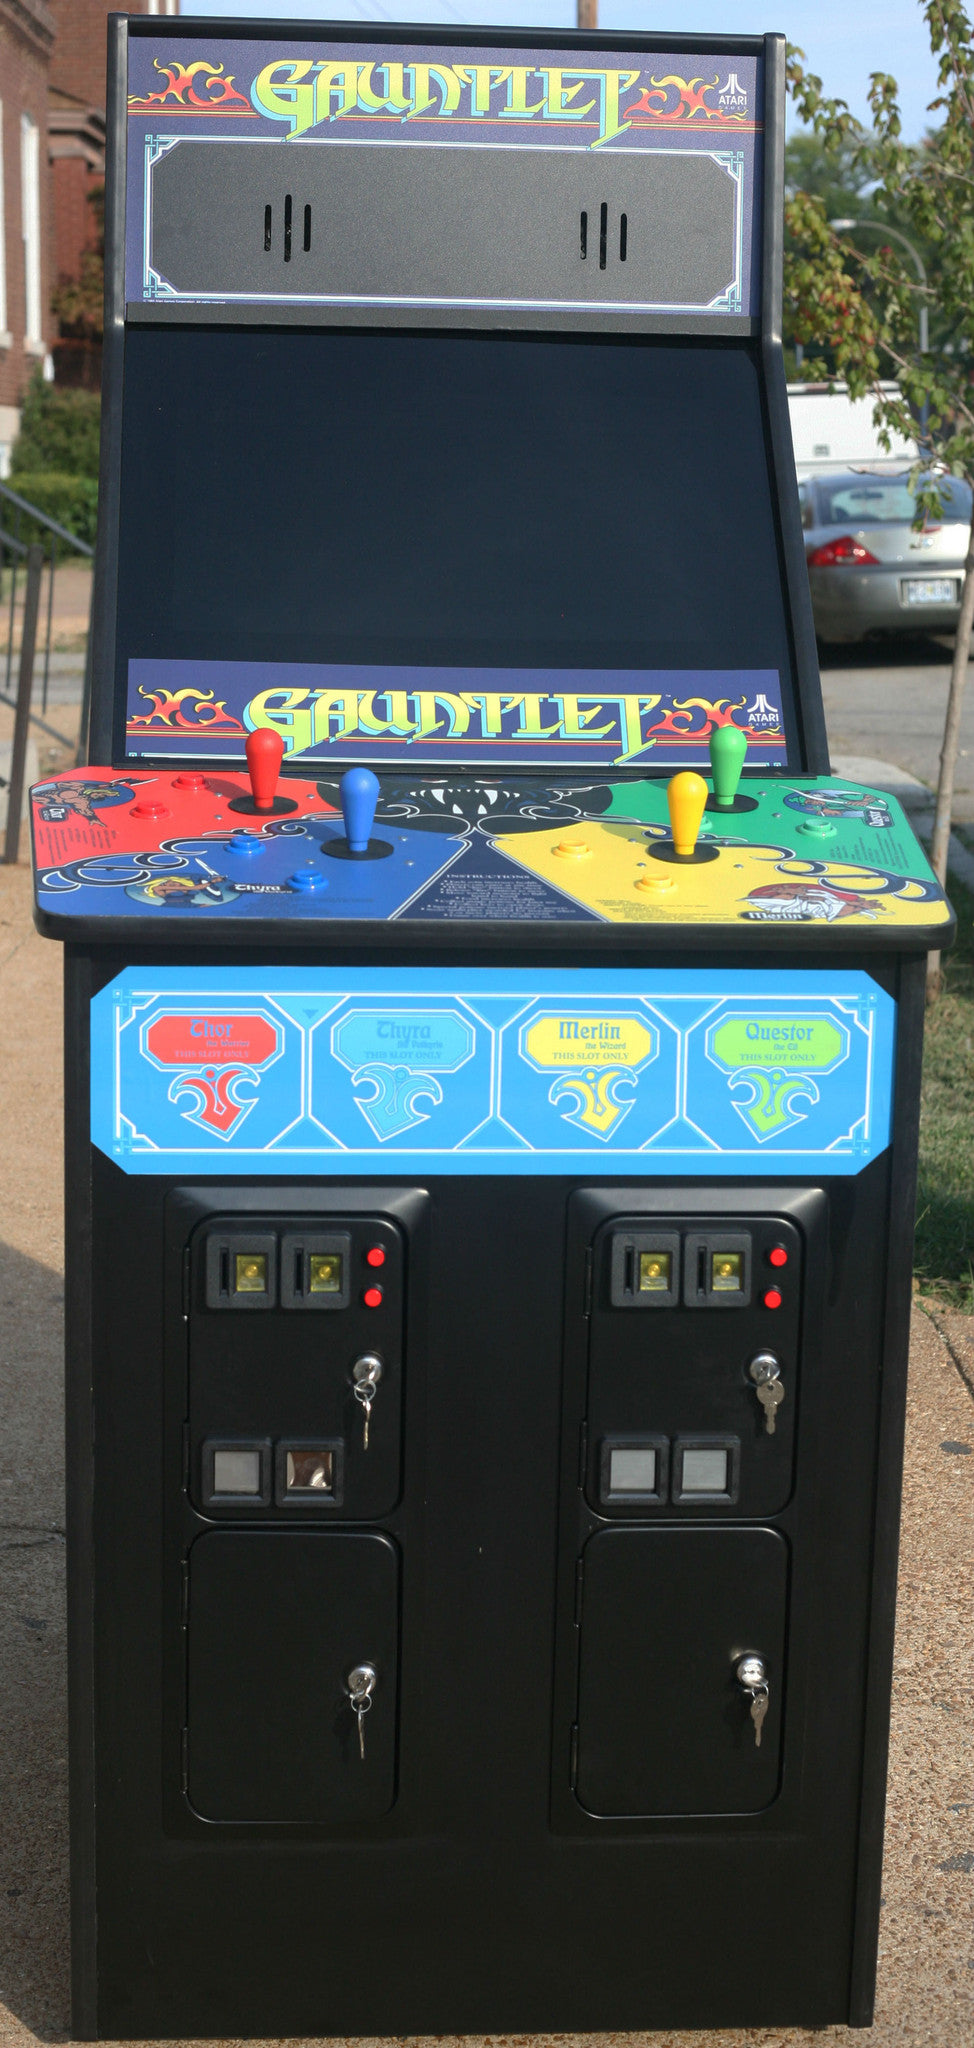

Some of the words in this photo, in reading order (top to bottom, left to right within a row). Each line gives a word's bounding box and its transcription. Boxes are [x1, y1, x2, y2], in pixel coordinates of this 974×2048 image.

[718, 95, 747, 105] ATARI
[250, 59, 641, 151] GAUNTLET
[748, 713, 779, 722] ATARI
[243, 687, 661, 767] GAUNTLET
[234, 883, 281, 893] Thyra
[748, 912, 803, 920] Merlin
[190, 1018, 233, 1038] Thor
[376, 1020, 431, 1043] Thyra
[559, 1021, 621, 1040] Merlin
[745, 1022, 815, 1041] Questor
[585, 1042, 597, 1050] the
[599, 1042, 627, 1050] Wizard
[773, 1043, 785, 1051] the
[174, 1050, 197, 1058] THIS
[198, 1050, 222, 1058] SLOT
[223, 1050, 250, 1058] ONLY
[364, 1051, 388, 1060] THIS
[389, 1051, 413, 1060] SLOT
[414, 1051, 443, 1060] ONLY
[552, 1052, 575, 1060] THIS
[576, 1052, 600, 1060] SLOT
[602, 1052, 630, 1060] ONLY
[739, 1053, 763, 1061] THIS
[763, 1053, 788, 1061] SLOT
[789, 1053, 817, 1061] ONLY
